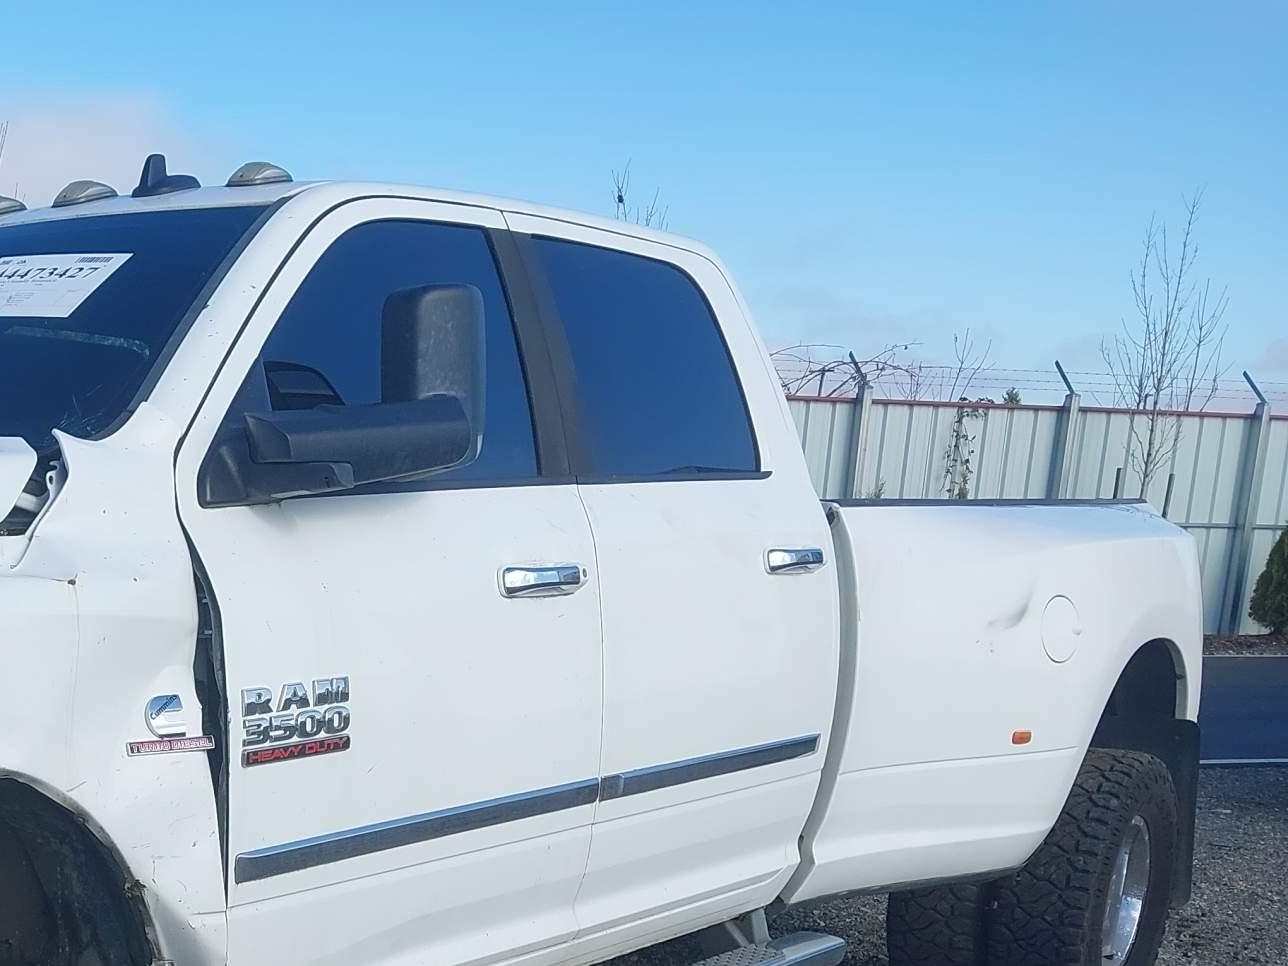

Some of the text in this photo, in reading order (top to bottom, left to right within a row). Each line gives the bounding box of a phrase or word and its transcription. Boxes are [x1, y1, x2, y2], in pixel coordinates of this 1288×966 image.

[150, 694, 178, 720] Cummins
[241, 676, 349, 717] RAM
[241, 705, 351, 747] 3500
[247, 737, 348, 763] HEAVY DUTY
